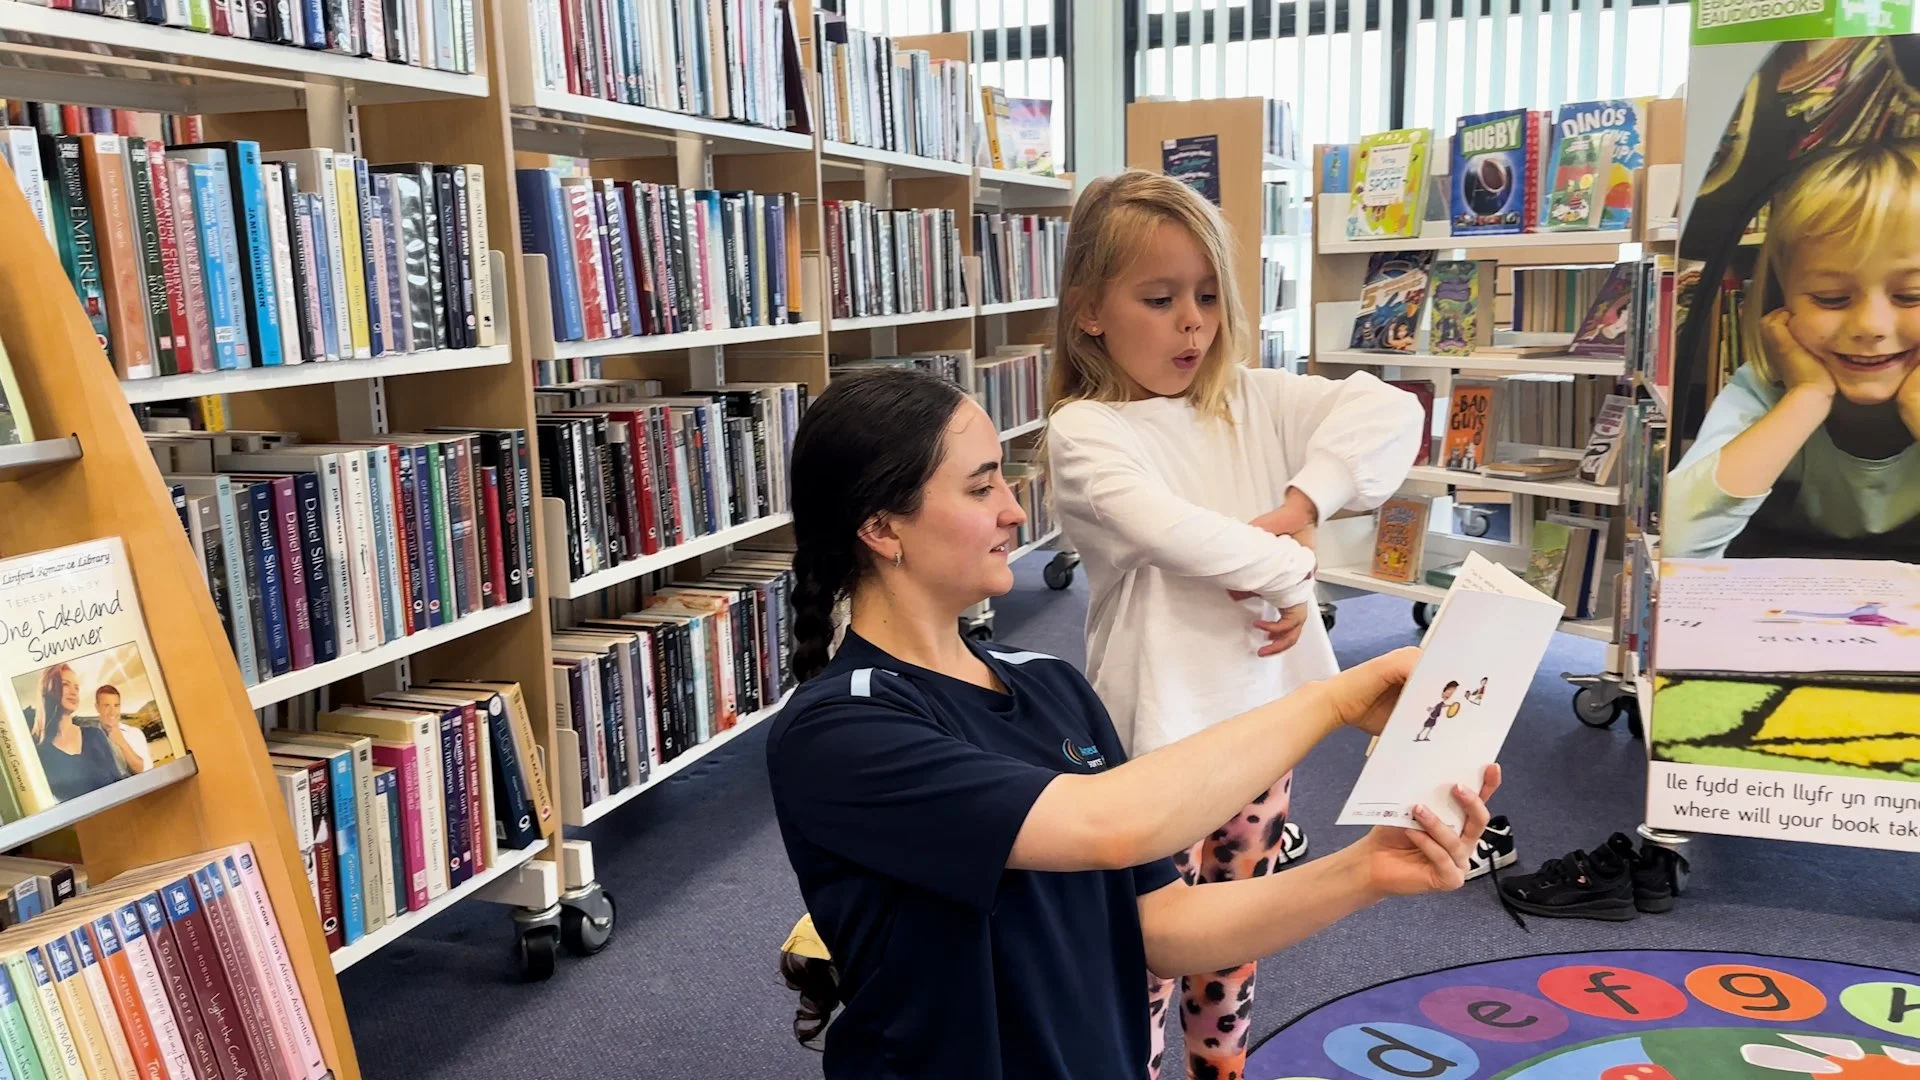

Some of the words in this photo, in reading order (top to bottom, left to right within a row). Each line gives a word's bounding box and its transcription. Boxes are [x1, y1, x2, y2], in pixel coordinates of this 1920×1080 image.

[1464, 118, 1520, 153] RUGBY
[1561, 108, 1627, 138] DINOS
[136, 169, 154, 229] Christmas
[145, 230, 159, 264] Child
[247, 207, 260, 242] JAMES
[457, 188, 468, 227] ROBERT
[68, 203, 101, 289] EMPIRE
[444, 224, 454, 246] RYAN
[460, 229, 470, 255] RYAN
[160, 246, 175, 296] RIVERS
[167, 247, 185, 316] CHRISTMAS
[251, 245, 267, 308] ROBERTSON
[261, 253, 273, 292] GIDEON
[147, 274, 160, 316] RIVERS
[155, 274, 168, 313] CAROL
[266, 294, 276, 326] MACK
[1460, 394, 1487, 413] BAD
[1452, 411, 1485, 432] GUYS
[474, 462, 482, 488] TITANS
[635, 436, 652, 492] SUSPECT
[331, 487, 341, 503] JOE
[369, 476, 380, 503] MAYA
[503, 466, 516, 505] Spindler
[518, 467, 530, 507] DUNBAR
[303, 497, 322, 542] Daniel
[418, 478, 433, 531] OFF-TARGET
[242, 519, 254, 551] Daniel
[256, 509, 275, 552] Daniel
[283, 510, 301, 553] Daniel
[333, 504, 345, 544] SIMPSON
[405, 520, 423, 561] Smith
[246, 554, 258, 578] Silva
[309, 547, 326, 581] Silva
[425, 540, 434, 558] EVE
[3, 566, 36, 585] Linford
[37, 562, 77, 577] Romance
[78, 552, 111, 568] Library
[262, 553, 279, 584] Silva
[289, 555, 305, 586] Silva
[427, 559, 437, 584] SMITH
[6, 592, 54, 609] TERESA
[37, 589, 124, 635] Lakeland
[268, 584, 282, 621] Moscow
[341, 595, 353, 629] GRAVITY
[27, 625, 103, 663] Summer
[271, 623, 287, 650] Rules
[657, 639, 665, 659] THE
[657, 660, 670, 705] SEAGULL
[453, 733, 465, 764] Quality
[466, 722, 475, 740] DEATH
[493, 718, 517, 767] FLIGHT
[422, 745, 433, 767] Rosie
[527, 752, 540, 777] BLACK
[360, 776, 368, 789] The
[424, 768, 437, 801] Thomas
[457, 766, 467, 792] Street
[533, 779, 547, 807] ROSES
[1666, 772, 1688, 790] lle
[1696, 775, 1738, 797] fydd
[1746, 779, 1785, 799] eich
[1793, 783, 1833, 806] llyfr
[1841, 791, 1865, 808] yn
[309, 786, 321, 817] TAYLOR
[317, 781, 330, 815] ANDREW
[361, 791, 373, 824] Perfume
[458, 793, 468, 815] Girls
[472, 801, 481, 825] Robert
[1673, 802, 1730, 820] where
[1738, 807, 1771, 824] will
[1778, 815, 1823, 830] your
[1832, 815, 1880, 834] book
[318, 843, 334, 882] Anatomy
[364, 826, 376, 865] Collector
[472, 827, 483, 866] Thorogood
[253, 889, 264, 905] SUE
[322, 886, 335, 915] Ghosts
[257, 904, 271, 927] COOK
[182, 918, 202, 953] DENISE
[208, 905, 224, 939] KAREN
[220, 941, 239, 981] ABBOTT
[267, 933, 285, 961] Tara's
[194, 954, 213, 989] ROBINS
[256, 948, 276, 986] COTTAGE
[276, 960, 297, 995] African
[134, 940, 151, 969] SALLY
[161, 1017, 179, 1041] Take
[159, 939, 178, 969] Toni
[170, 974, 196, 1023] Anders
[191, 1028, 213, 1064] Rivals
[202, 990, 230, 1026] Light
[274, 998, 286, 1016] THE
[1583, 971, 1640, 1015] f
[1718, 973, 1793, 1013] g
[42, 986, 60, 1016] ANNE
[52, 1015, 78, 1067] HEWLAND
[116, 972, 136, 1008] WENDY
[129, 1009, 150, 1048] KREMER
[251, 992, 267, 1019] Change
[264, 1028, 278, 1051] Heart
[289, 995, 315, 1046] Adventure
[1466, 1000, 1540, 1030] e
[218, 1023, 236, 1044] the
[279, 1014, 300, 1056] COUNTRY
[1360, 1025, 1459, 1079] d
